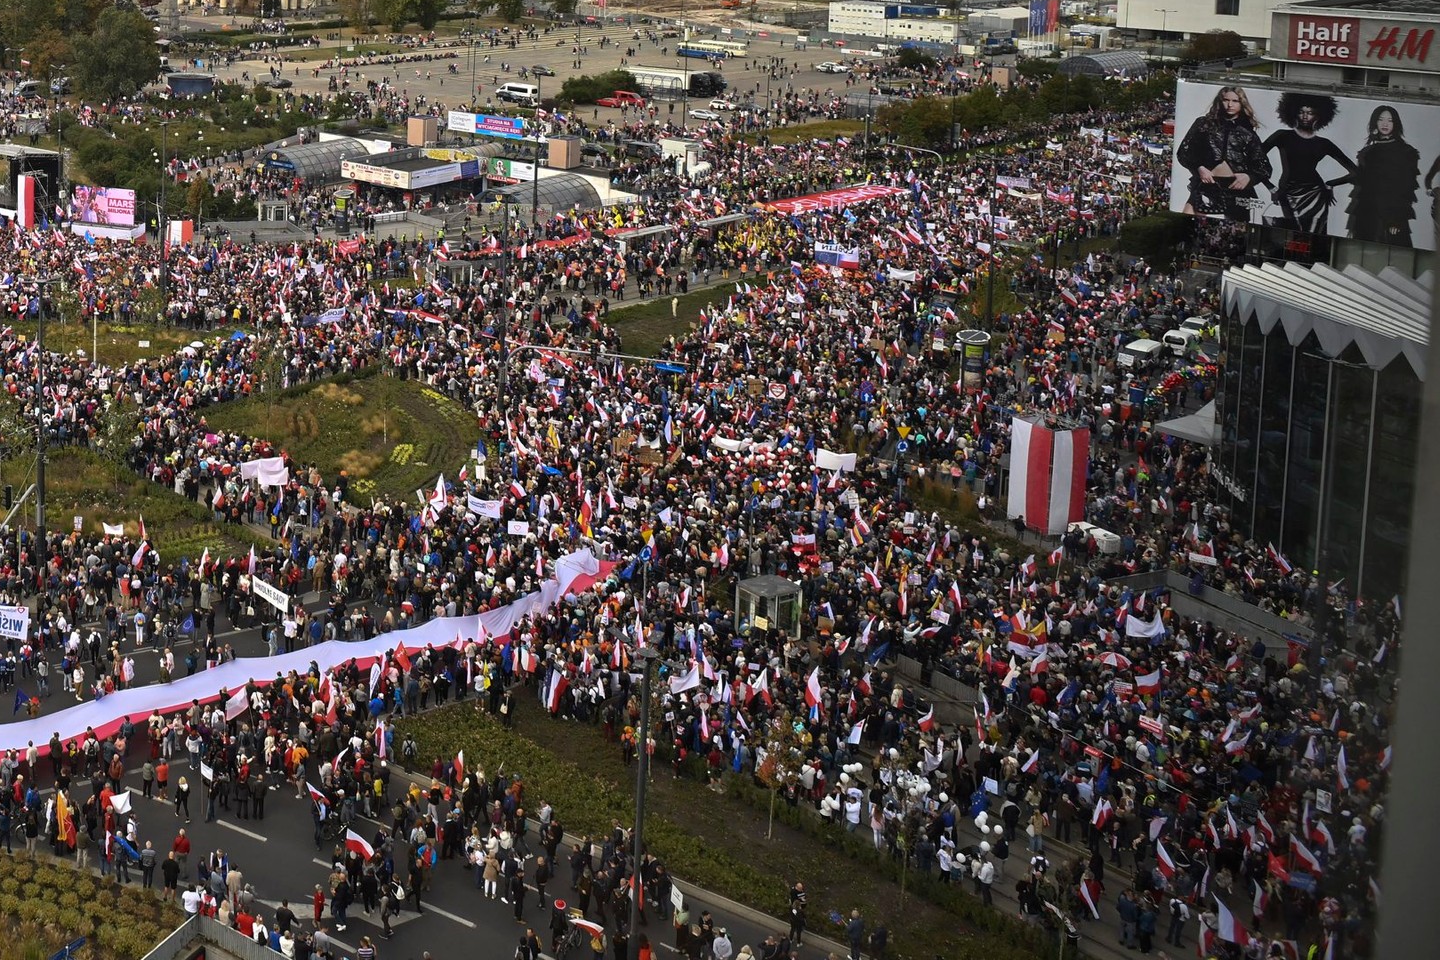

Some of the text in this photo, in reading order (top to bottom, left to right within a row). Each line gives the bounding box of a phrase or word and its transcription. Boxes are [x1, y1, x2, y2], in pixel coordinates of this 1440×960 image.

[1297, 21, 1352, 42] Half
[1296, 40, 1350, 59] Price
[1365, 26, 1435, 64] H&M
